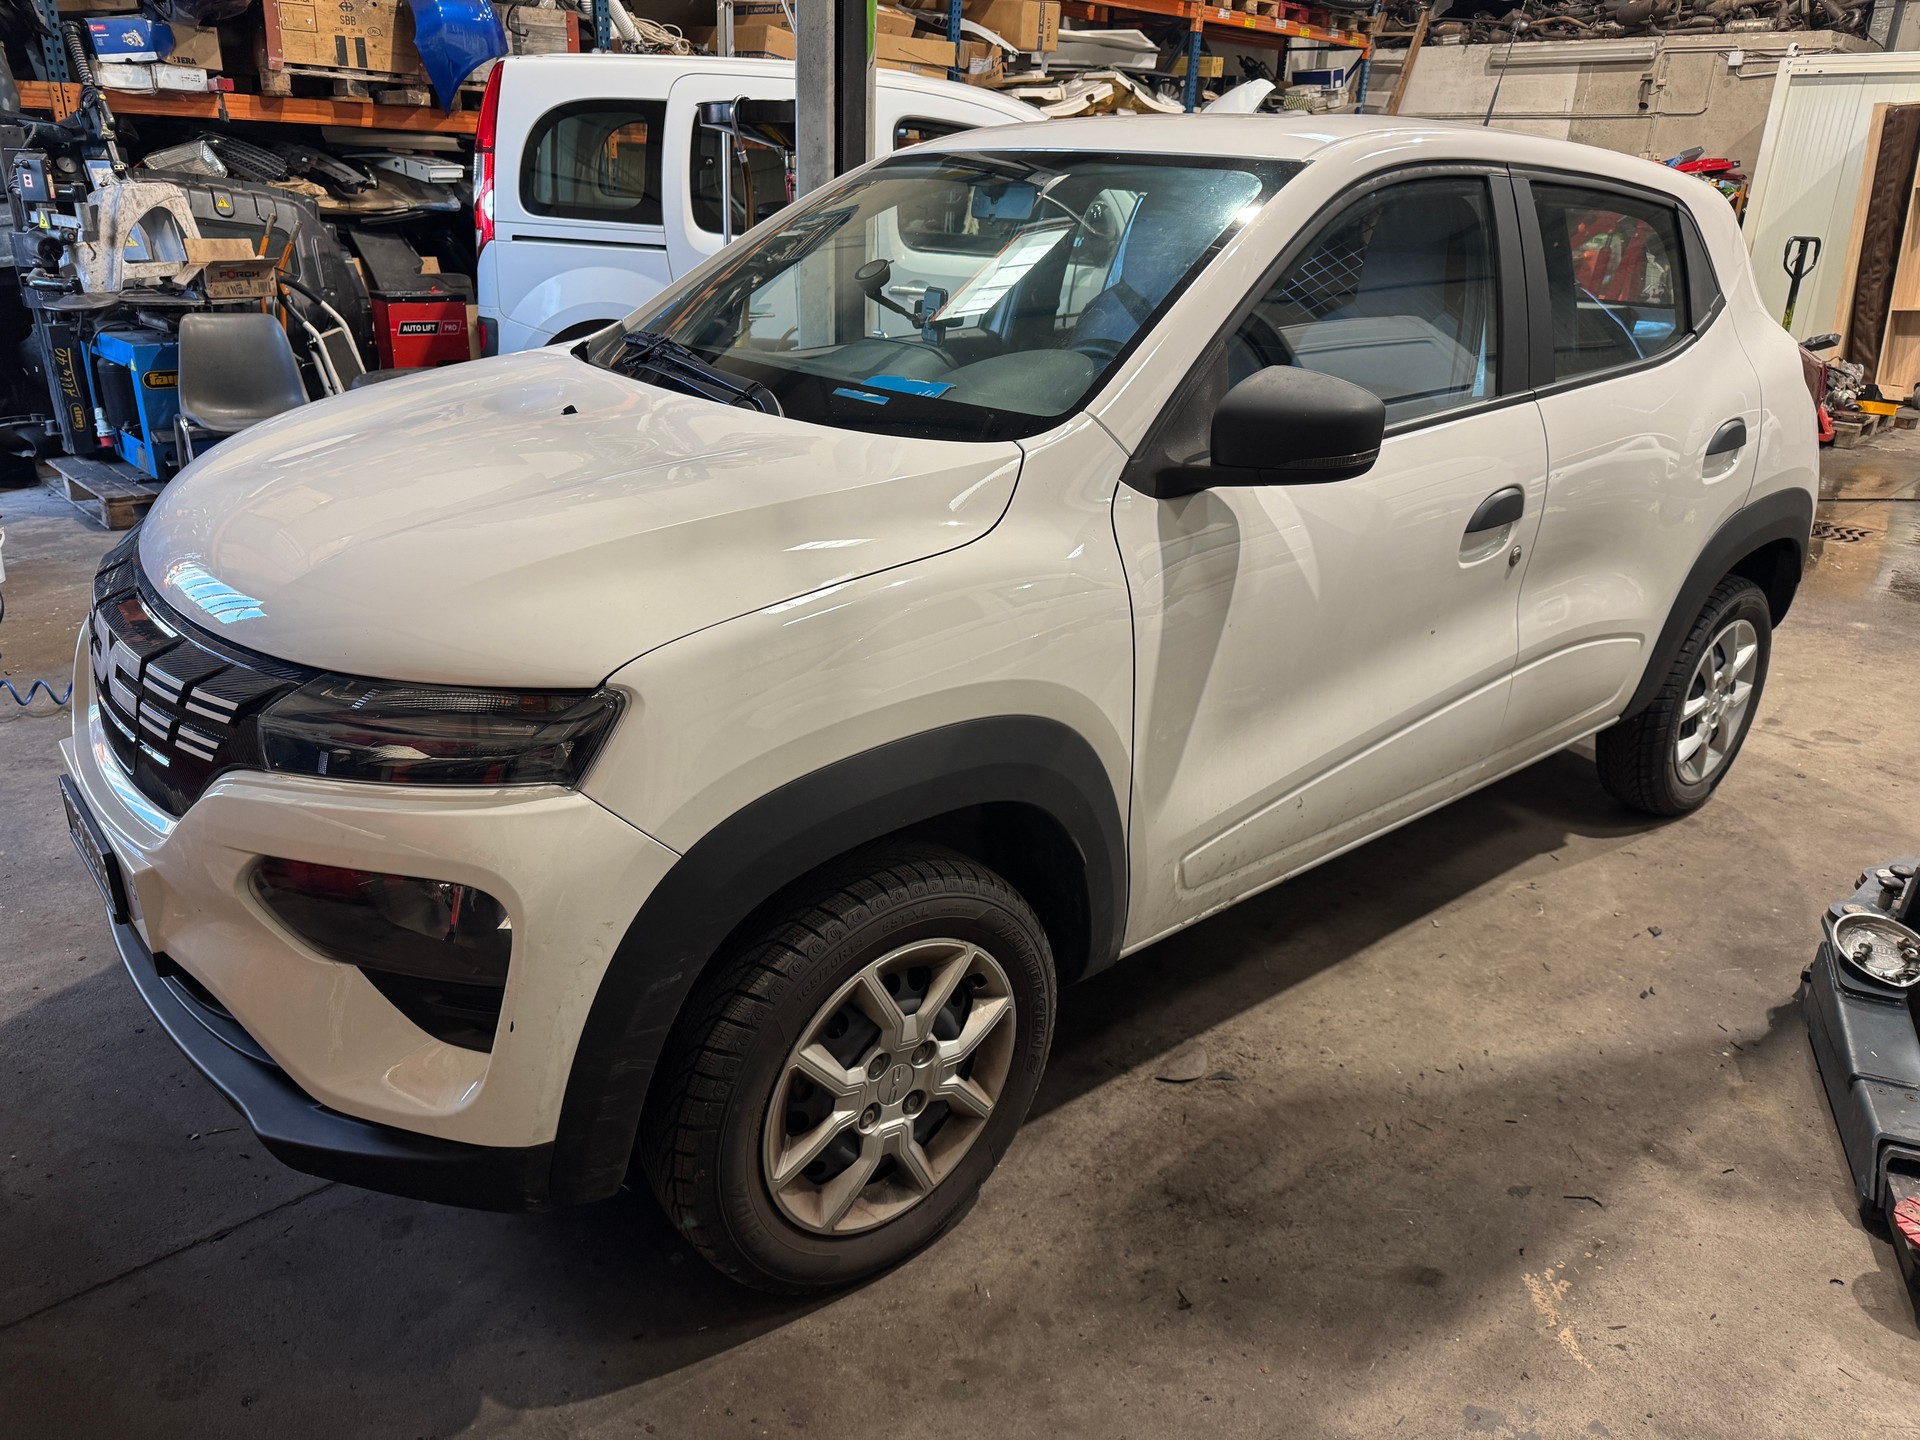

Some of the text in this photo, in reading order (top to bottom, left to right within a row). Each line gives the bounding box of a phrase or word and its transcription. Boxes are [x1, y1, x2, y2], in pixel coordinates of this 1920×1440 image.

[339, 15, 357, 26] SBB
[402, 324, 421, 332] AUTO
[54, 347, 69, 366] 40
[1026, 1052, 1041, 1076] 2
